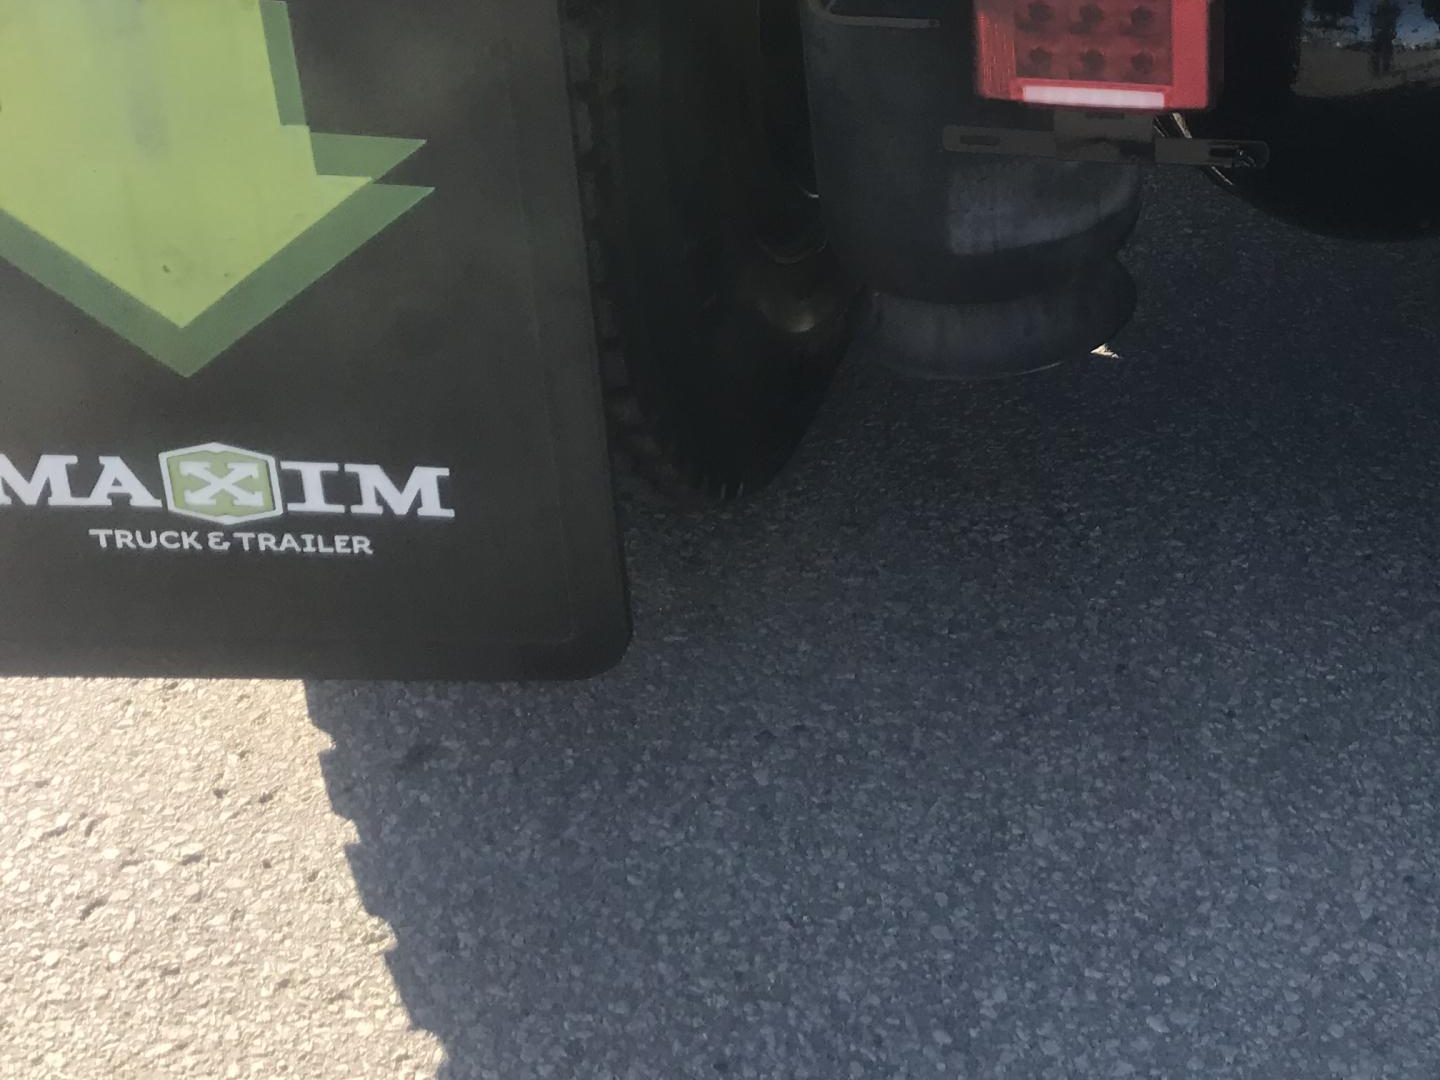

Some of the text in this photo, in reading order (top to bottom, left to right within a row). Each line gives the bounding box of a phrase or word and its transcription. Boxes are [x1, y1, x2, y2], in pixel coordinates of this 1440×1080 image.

[0, 450, 456, 520] MAXIM
[88, 528, 374, 555] TRUCK & TRAILER
